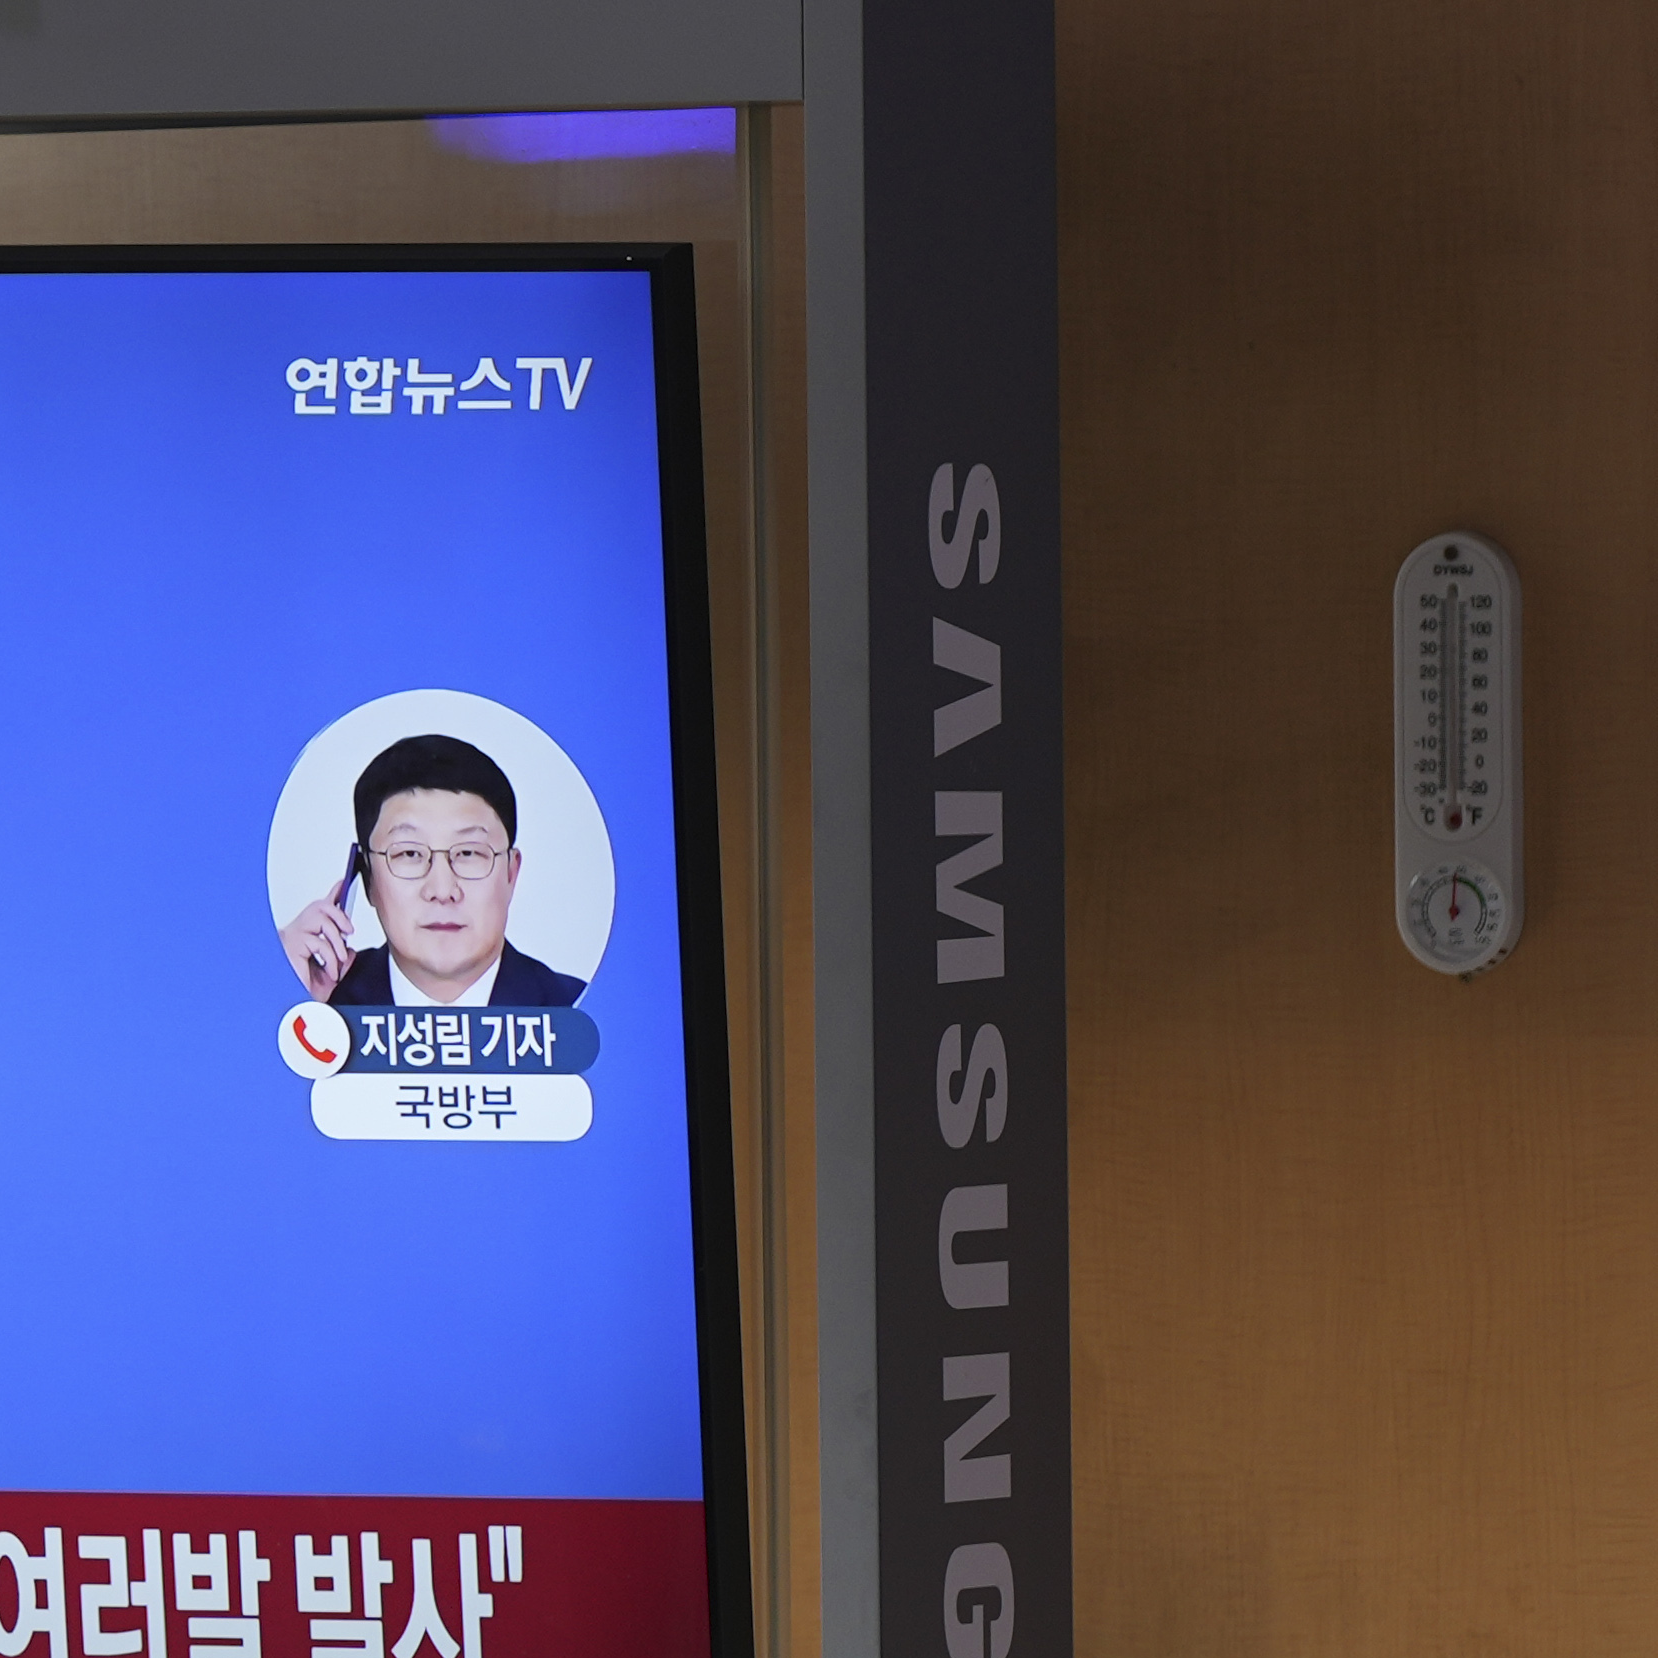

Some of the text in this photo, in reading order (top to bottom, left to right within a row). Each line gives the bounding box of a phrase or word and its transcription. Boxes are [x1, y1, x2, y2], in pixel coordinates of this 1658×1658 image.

[285, 356, 593, 415] 연합뉴스TV
[360, 1012, 557, 1067] 지성림 기자
[394, 1084, 518, 1130] 국방부
